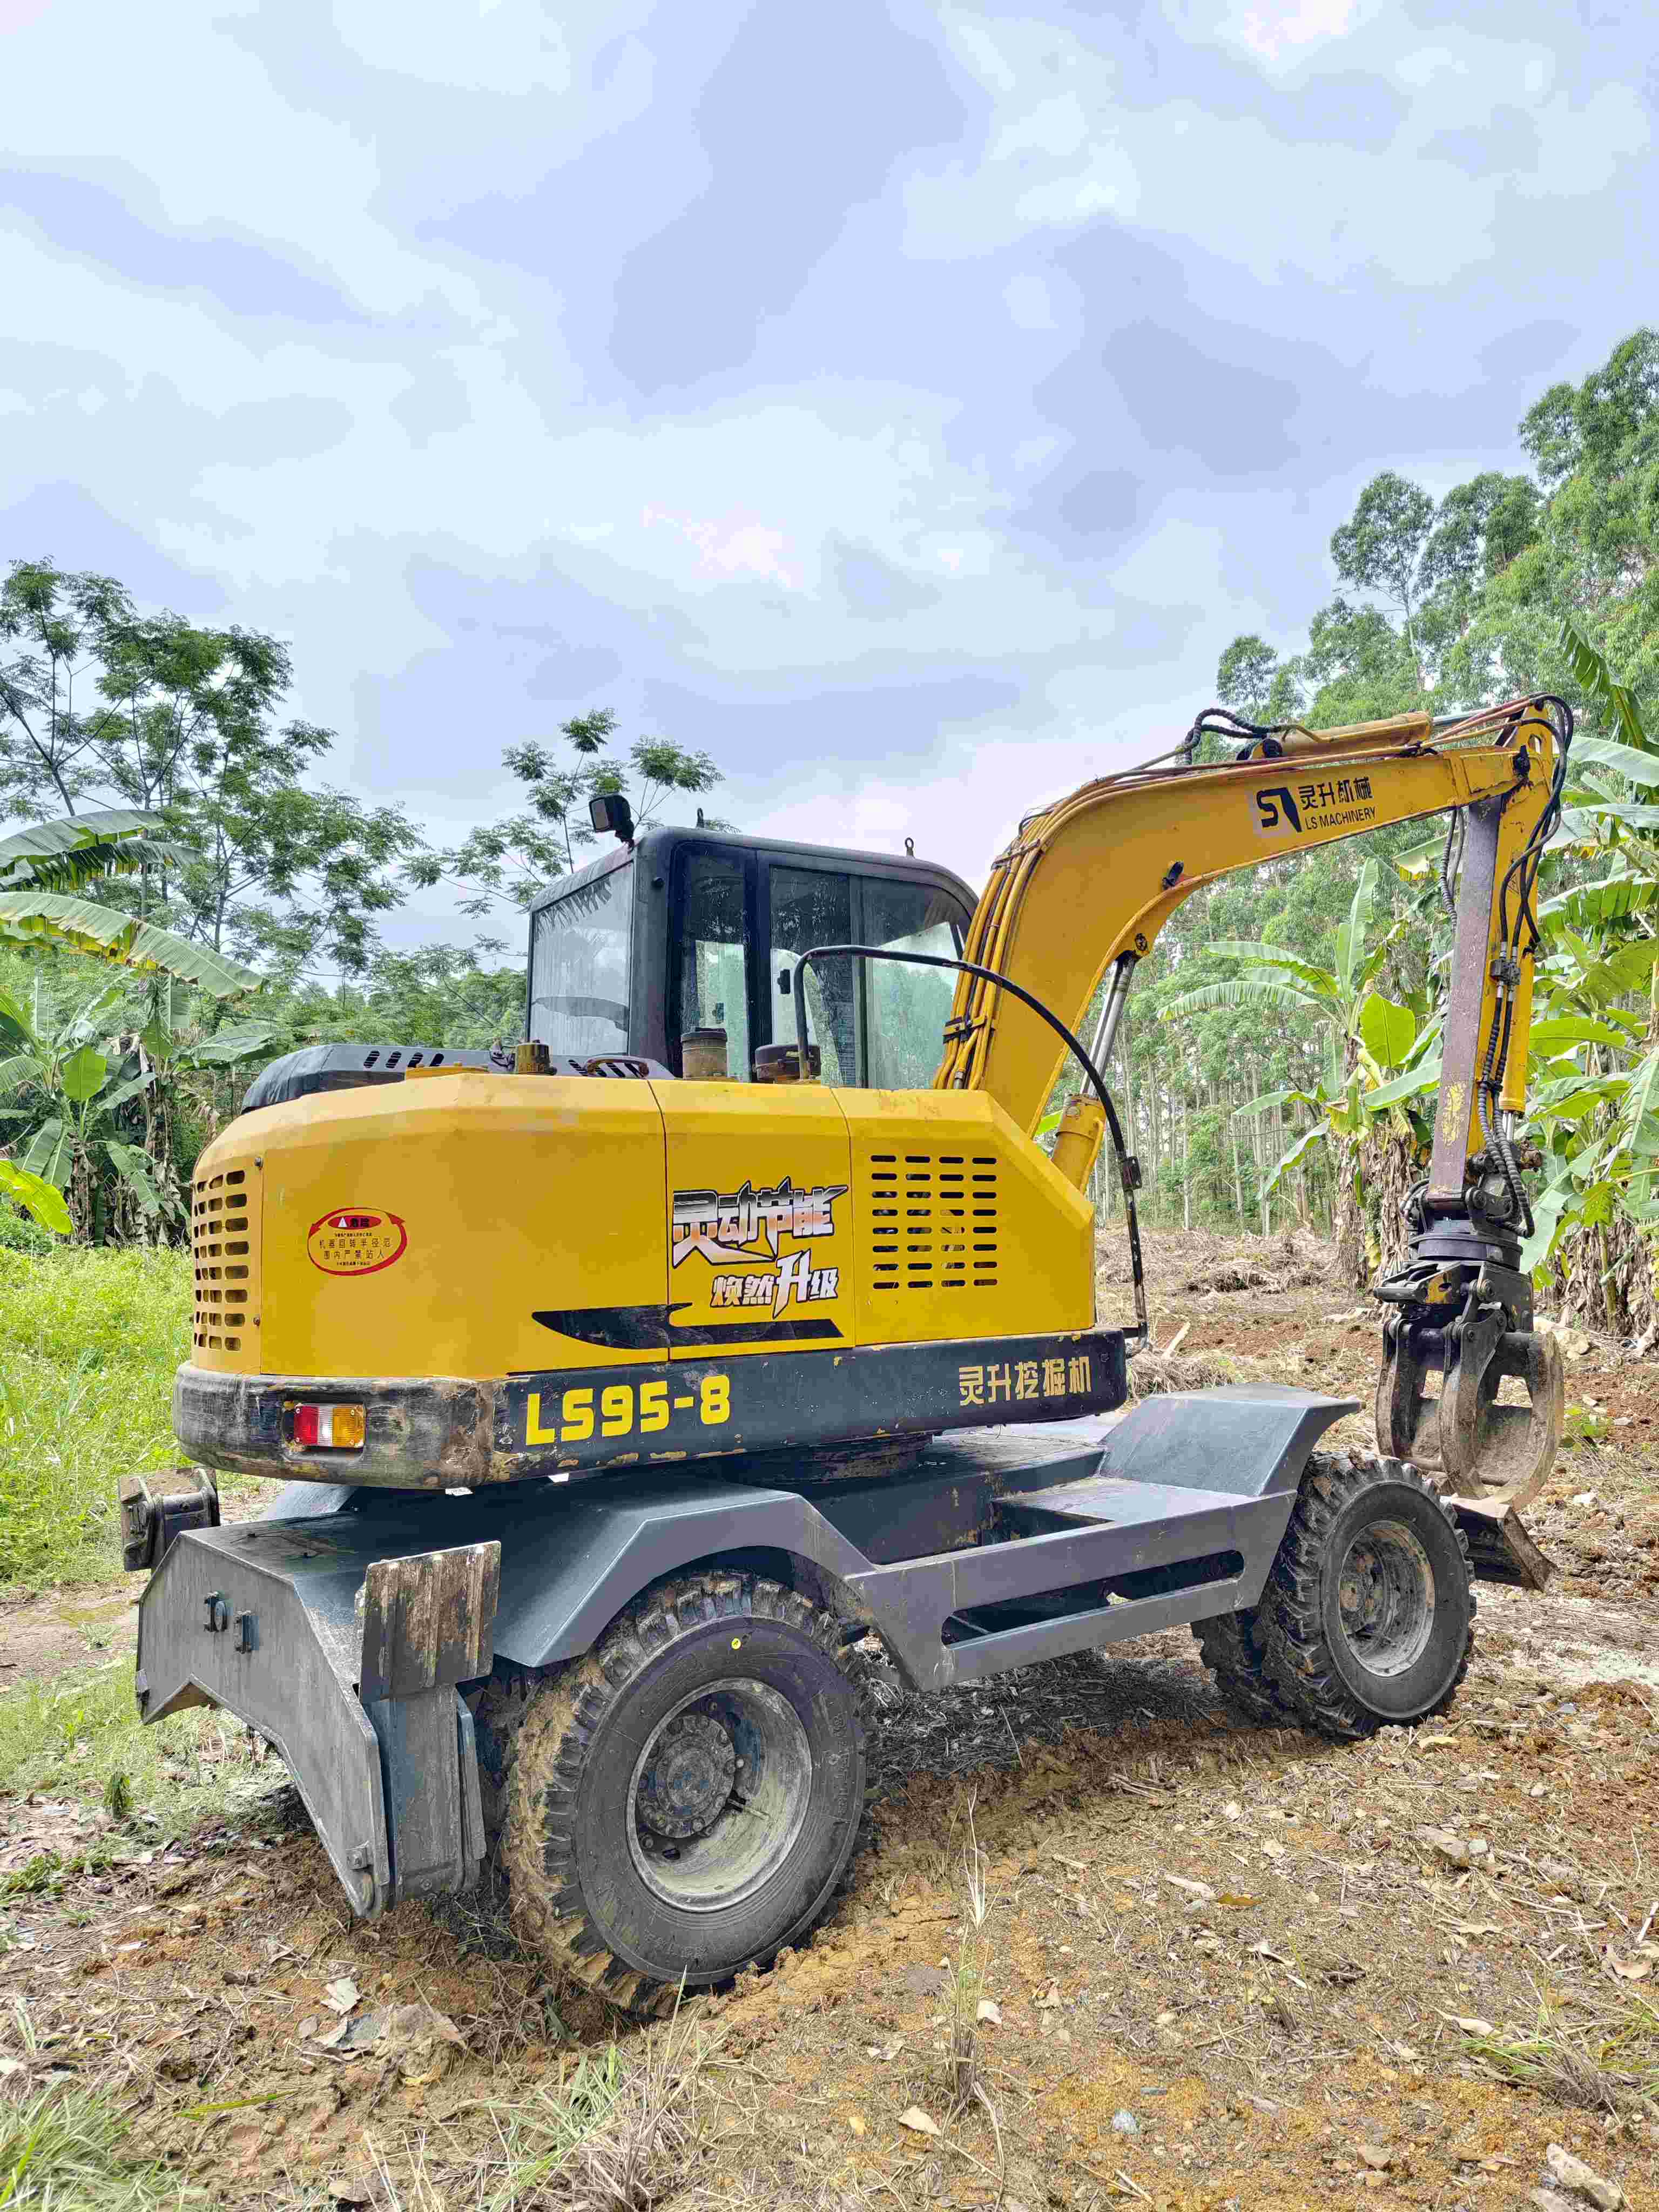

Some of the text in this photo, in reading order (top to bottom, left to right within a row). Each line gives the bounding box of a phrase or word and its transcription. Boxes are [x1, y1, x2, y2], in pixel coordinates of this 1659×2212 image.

[1298, 776, 1374, 810] 灵升机械
[1305, 806, 1376, 831] LS MACHINERY
[671, 1176, 849, 1270] 灵动节能
[710, 1247, 839, 1319] 焕然升级
[525, 1374, 731, 1446] LS95-8
[959, 1356, 1092, 1406] 灵升挖掘机
